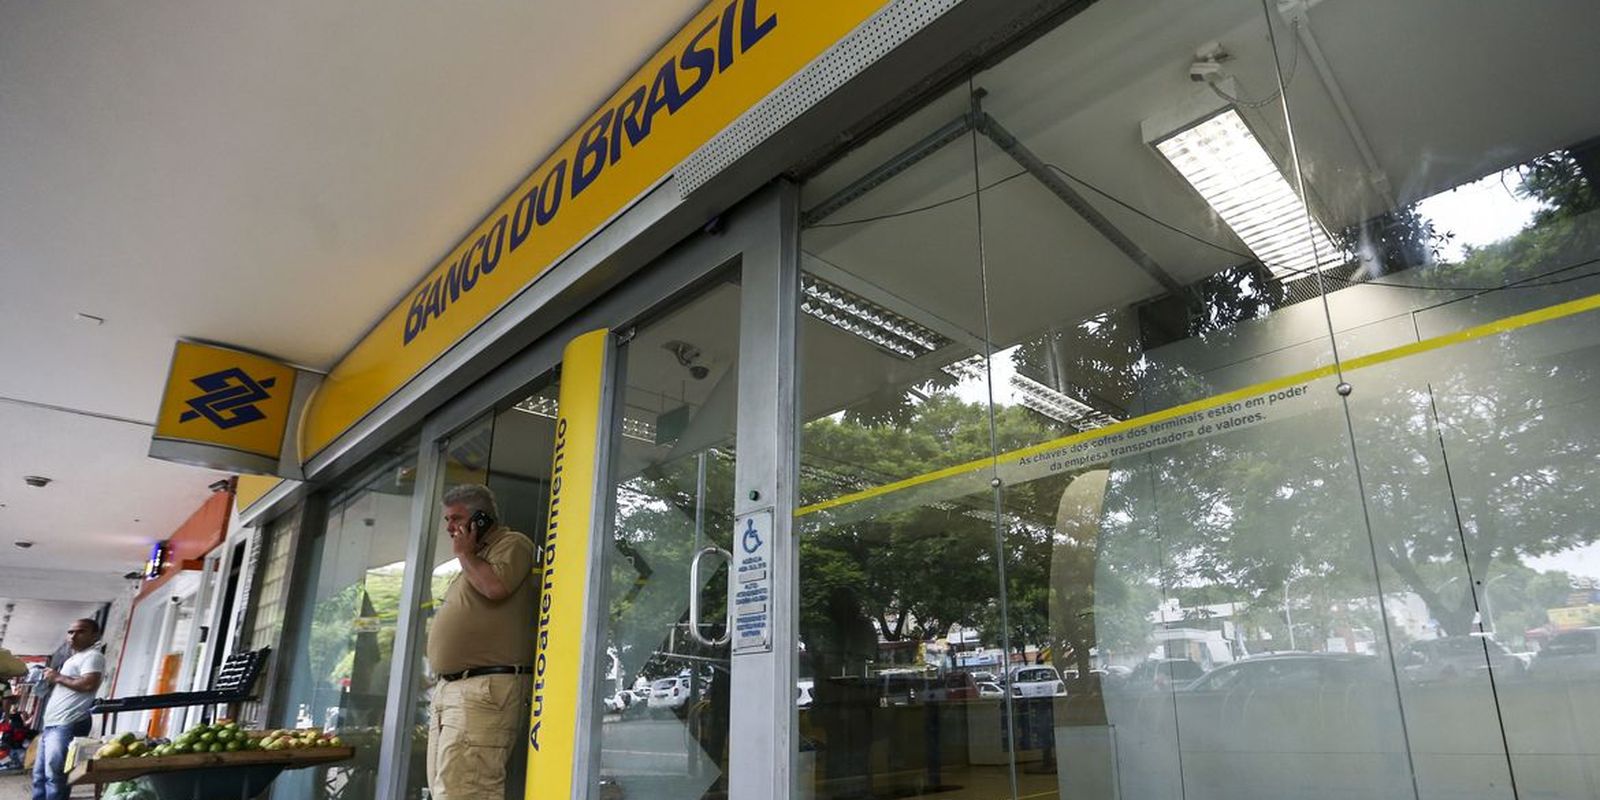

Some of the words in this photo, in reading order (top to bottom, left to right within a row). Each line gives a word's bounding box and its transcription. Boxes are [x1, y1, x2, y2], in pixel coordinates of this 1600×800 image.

[404, 214, 508, 346] BANCO
[509, 159, 567, 253] DO
[571, 0, 777, 199] BRASIL
[1019, 456, 1031, 466] As
[1033, 448, 1067, 462] chaves
[1070, 441, 1089, 453] dos
[1091, 434, 1124, 447] cofres
[1127, 427, 1148, 439] dos
[1150, 413, 1205, 433] terminais
[1207, 403, 1242, 418] estão
[1245, 397, 1265, 408] em
[1269, 385, 1308, 405] poder
[1050, 461, 1062, 471] da
[1064, 451, 1108, 468] empresa
[1110, 430, 1194, 454] transportadora
[1197, 423, 1212, 436] de
[1216, 411, 1267, 430] valores.
[529, 417, 567, 751] Autoatendimento
